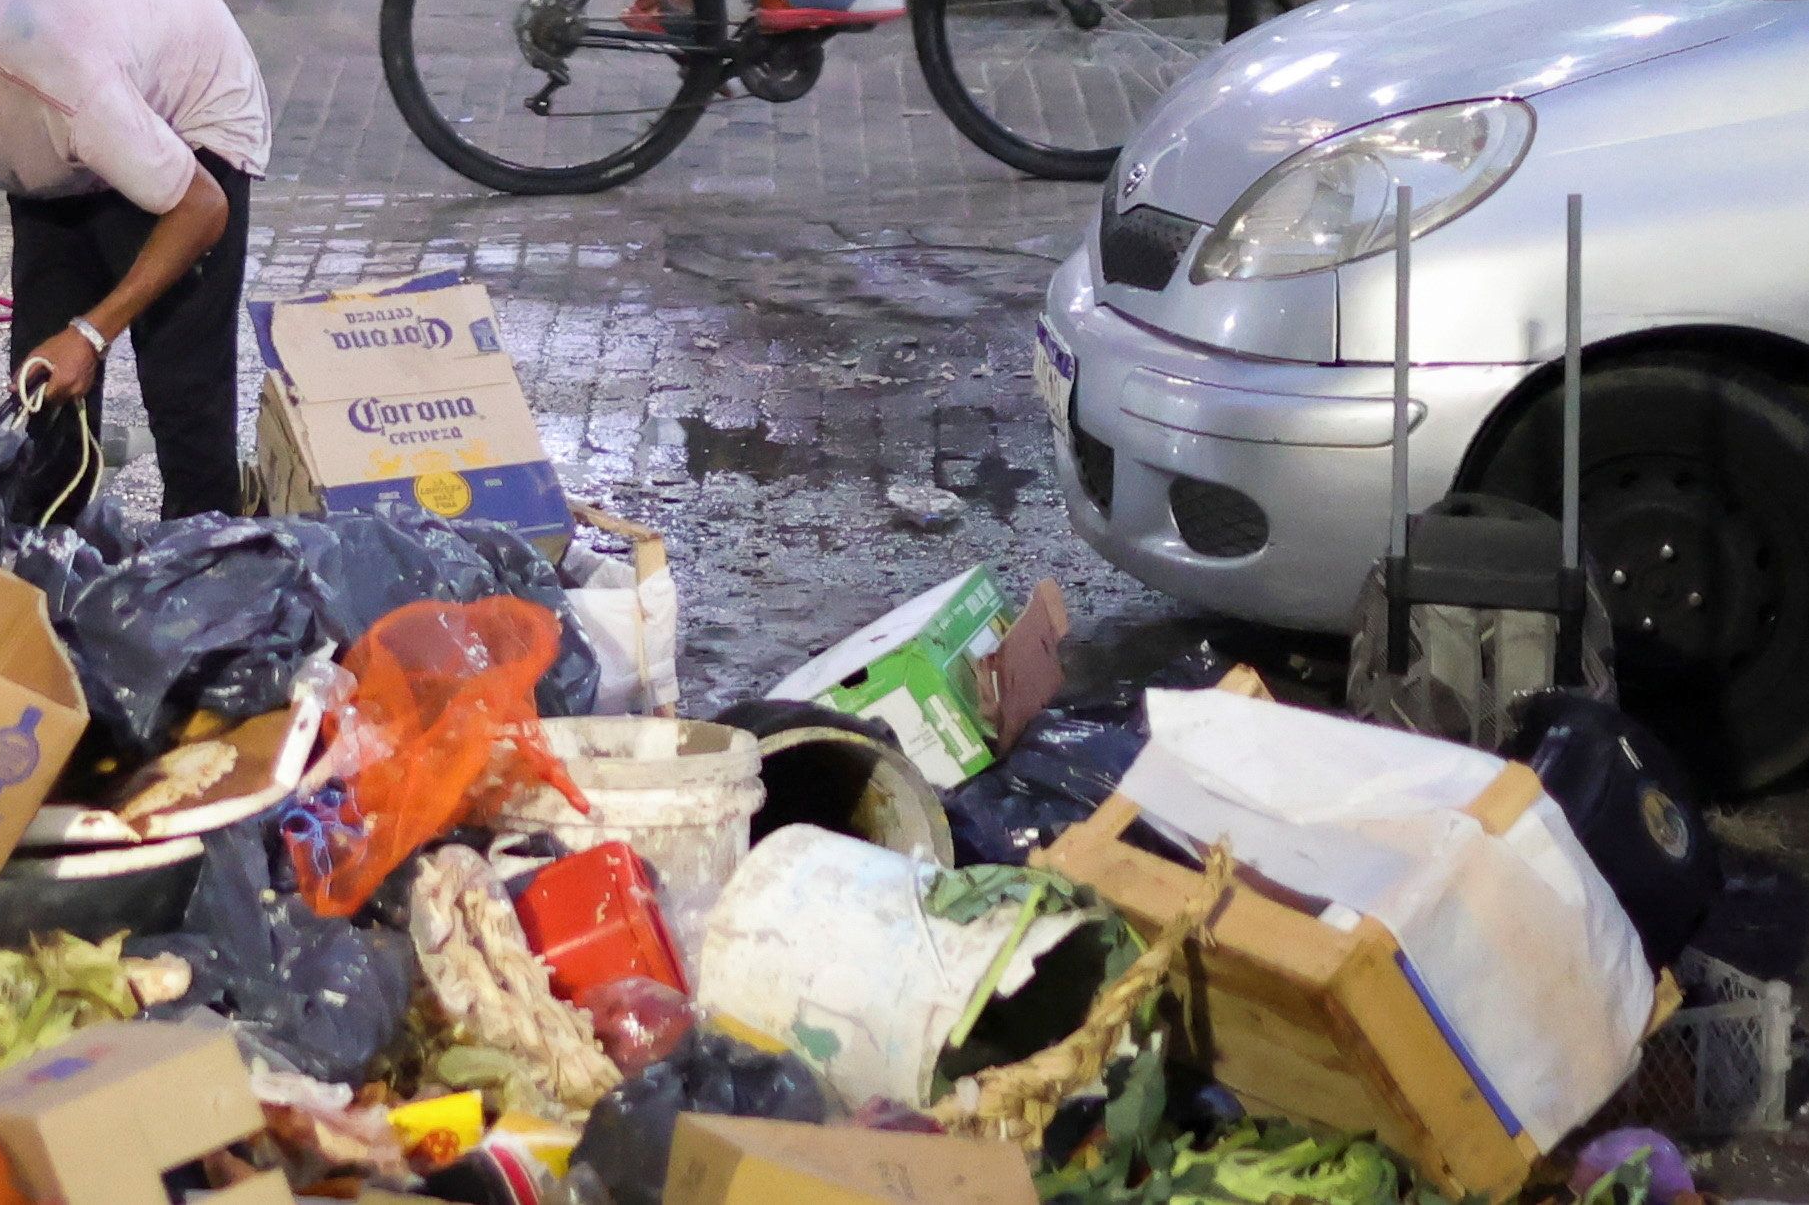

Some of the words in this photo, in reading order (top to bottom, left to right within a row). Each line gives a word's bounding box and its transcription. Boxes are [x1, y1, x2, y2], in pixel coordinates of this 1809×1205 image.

[345, 307, 414, 324] cerveza
[330, 314, 453, 350] Corona
[348, 396, 476, 435] Corona
[389, 426, 463, 445] cerveza
